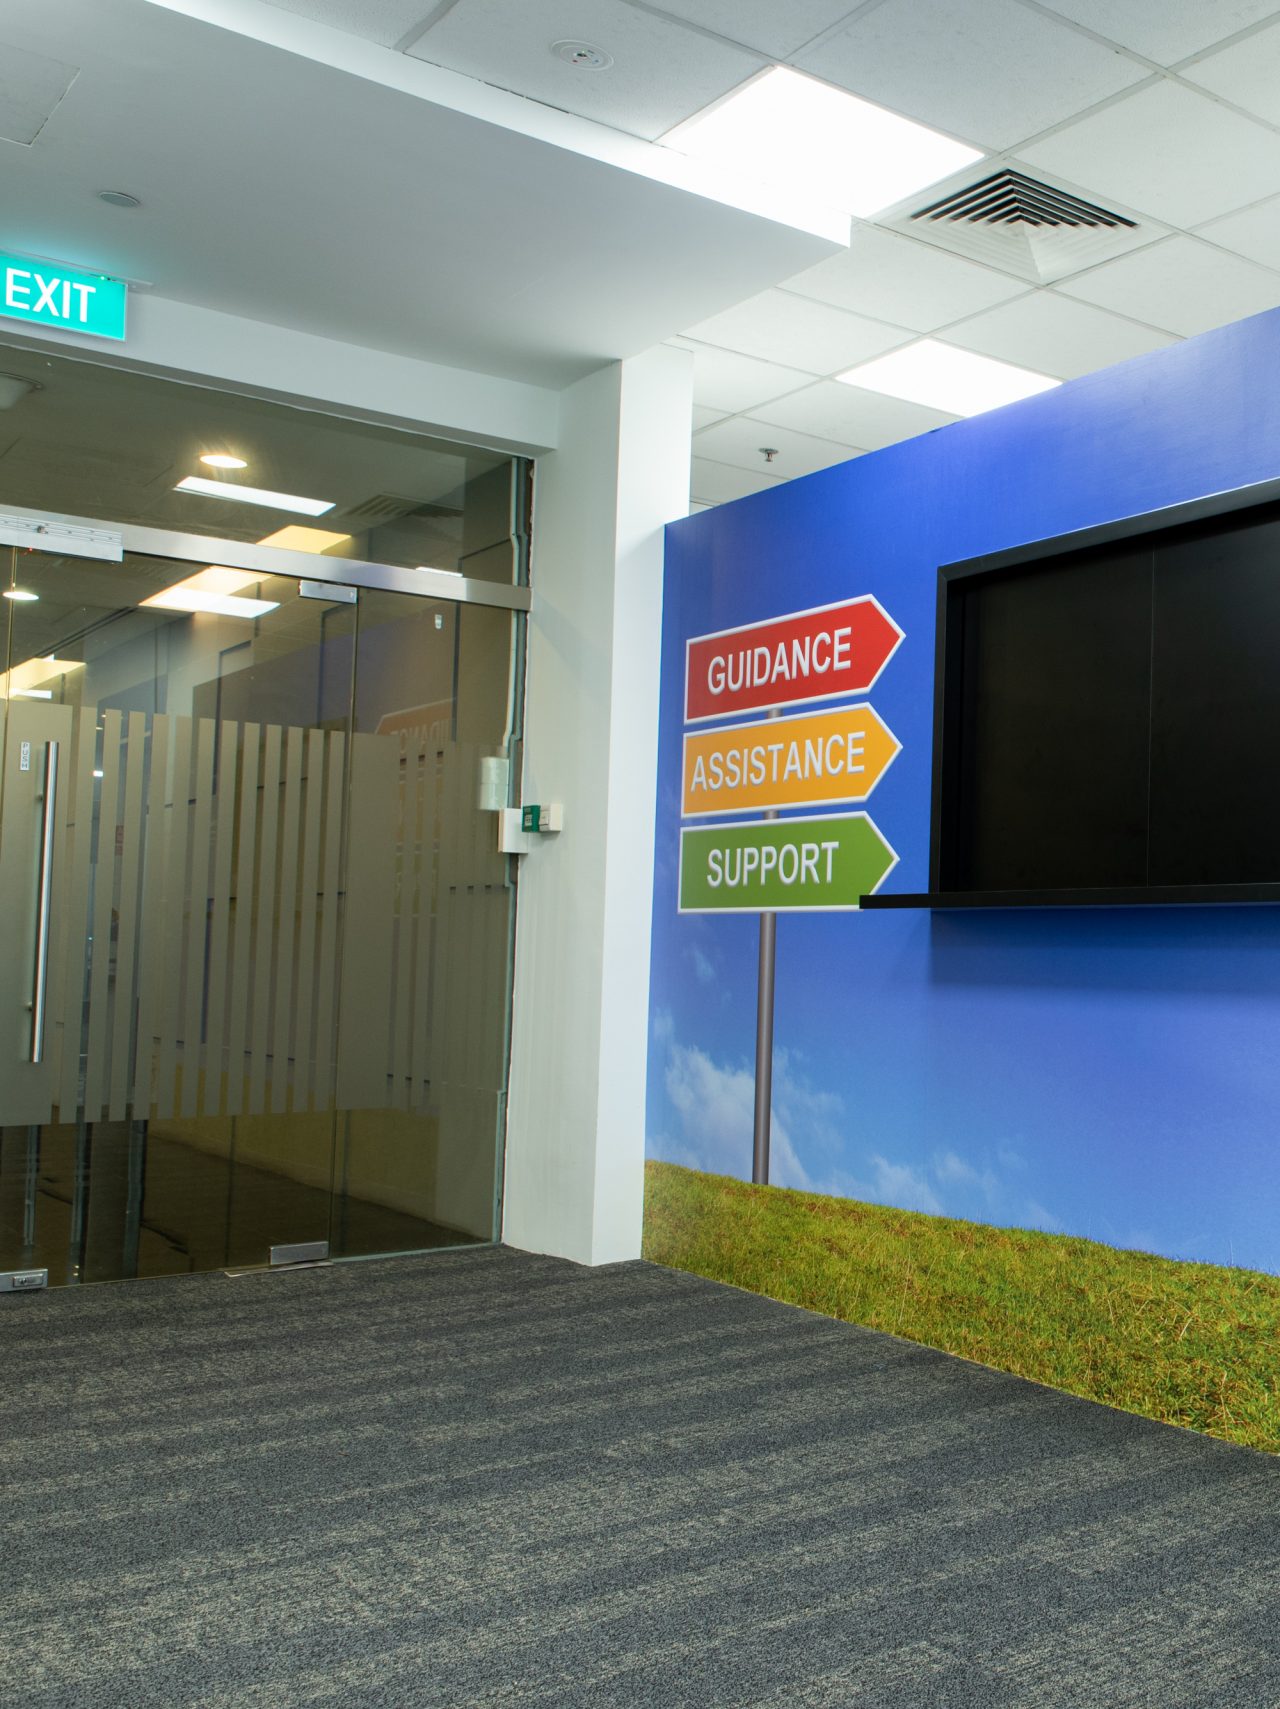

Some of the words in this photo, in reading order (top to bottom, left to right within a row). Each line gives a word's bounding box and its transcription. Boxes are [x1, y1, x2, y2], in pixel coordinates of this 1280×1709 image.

[5, 267, 96, 323] EXIT
[707, 626, 852, 695] GUIDANCE
[21, 742, 29, 769] PUSH
[690, 730, 866, 792] ASSISTANCE
[706, 841, 840, 888] SUPPORT
